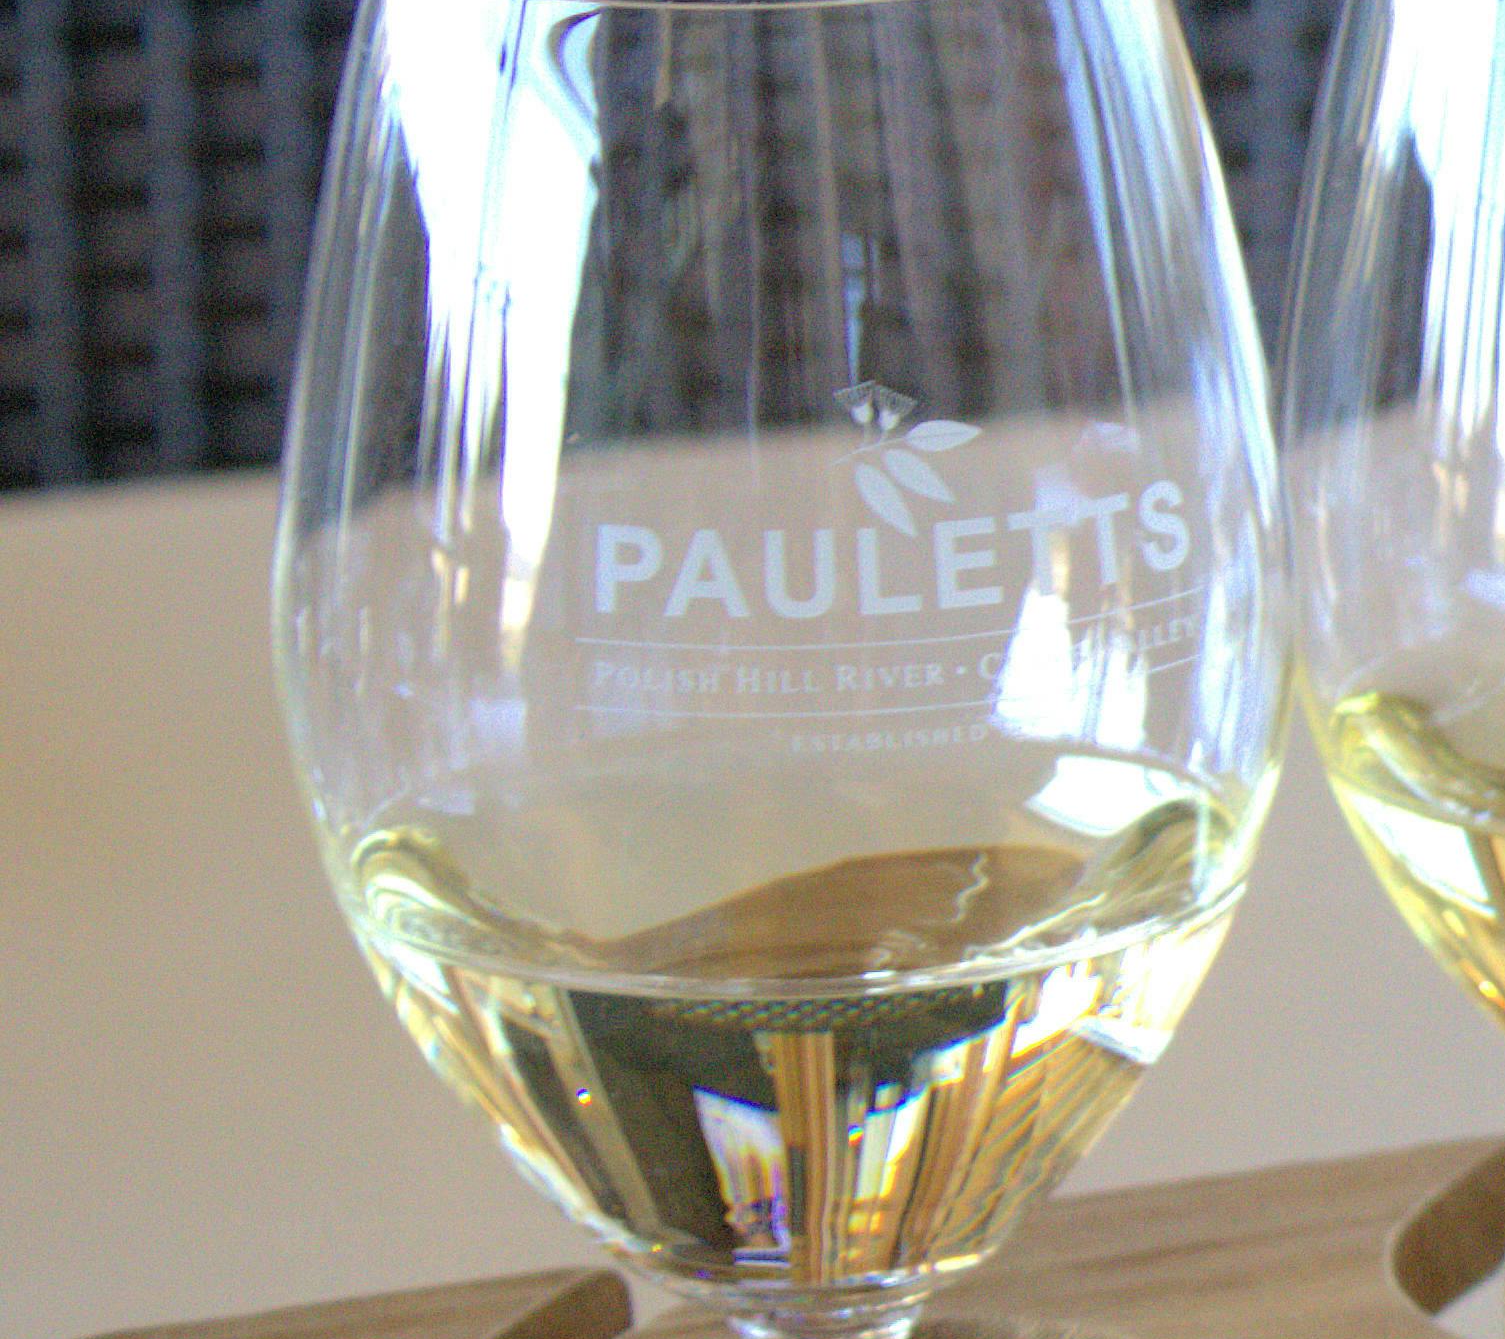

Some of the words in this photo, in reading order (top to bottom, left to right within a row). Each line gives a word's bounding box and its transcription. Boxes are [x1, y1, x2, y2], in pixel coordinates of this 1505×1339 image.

[595, 480, 1190, 619] PAULETTS
[734, 661, 819, 695] HILL
[836, 660, 944, 693] RIVER
